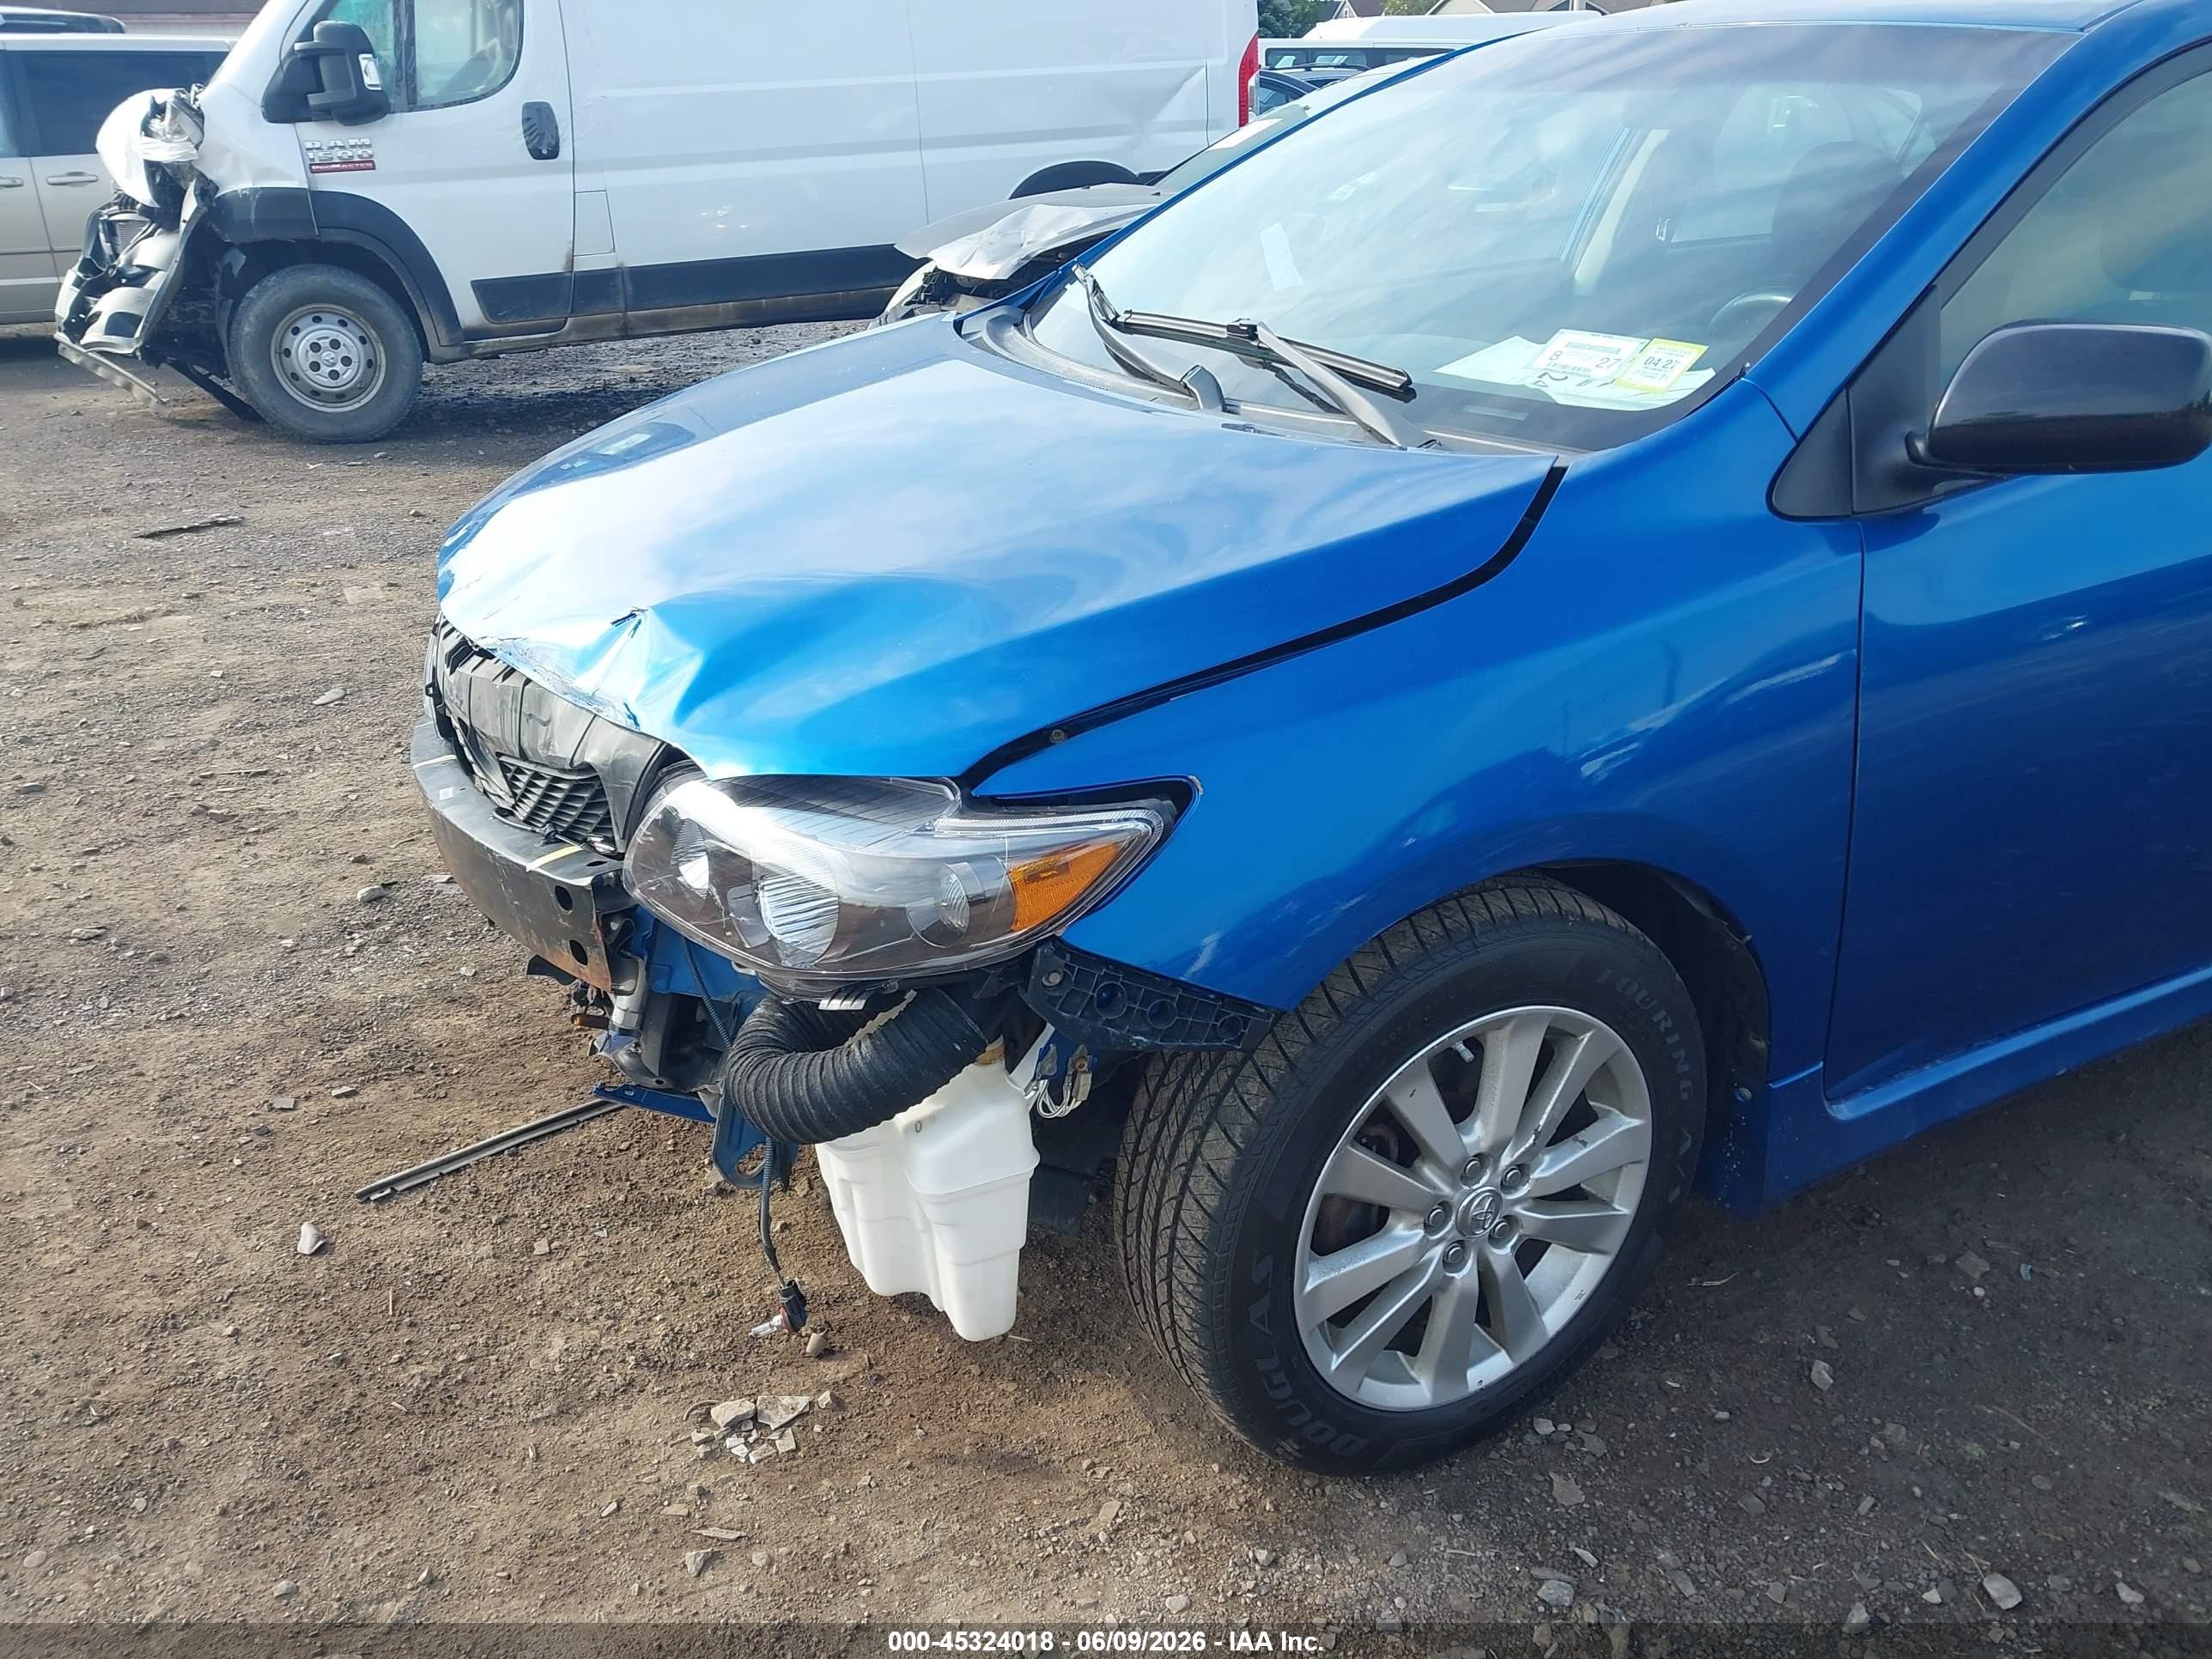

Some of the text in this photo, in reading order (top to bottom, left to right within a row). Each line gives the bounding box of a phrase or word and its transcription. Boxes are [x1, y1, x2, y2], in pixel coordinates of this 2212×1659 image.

[304, 137, 373, 151] RAM
[307, 149, 374, 162] 1500
[1549, 349, 1563, 361] 8
[1595, 356, 1622, 369] 27
[1594, 969, 1693, 1101] TOURING
[1249, 1249, 1370, 1458] DOUGLAS
